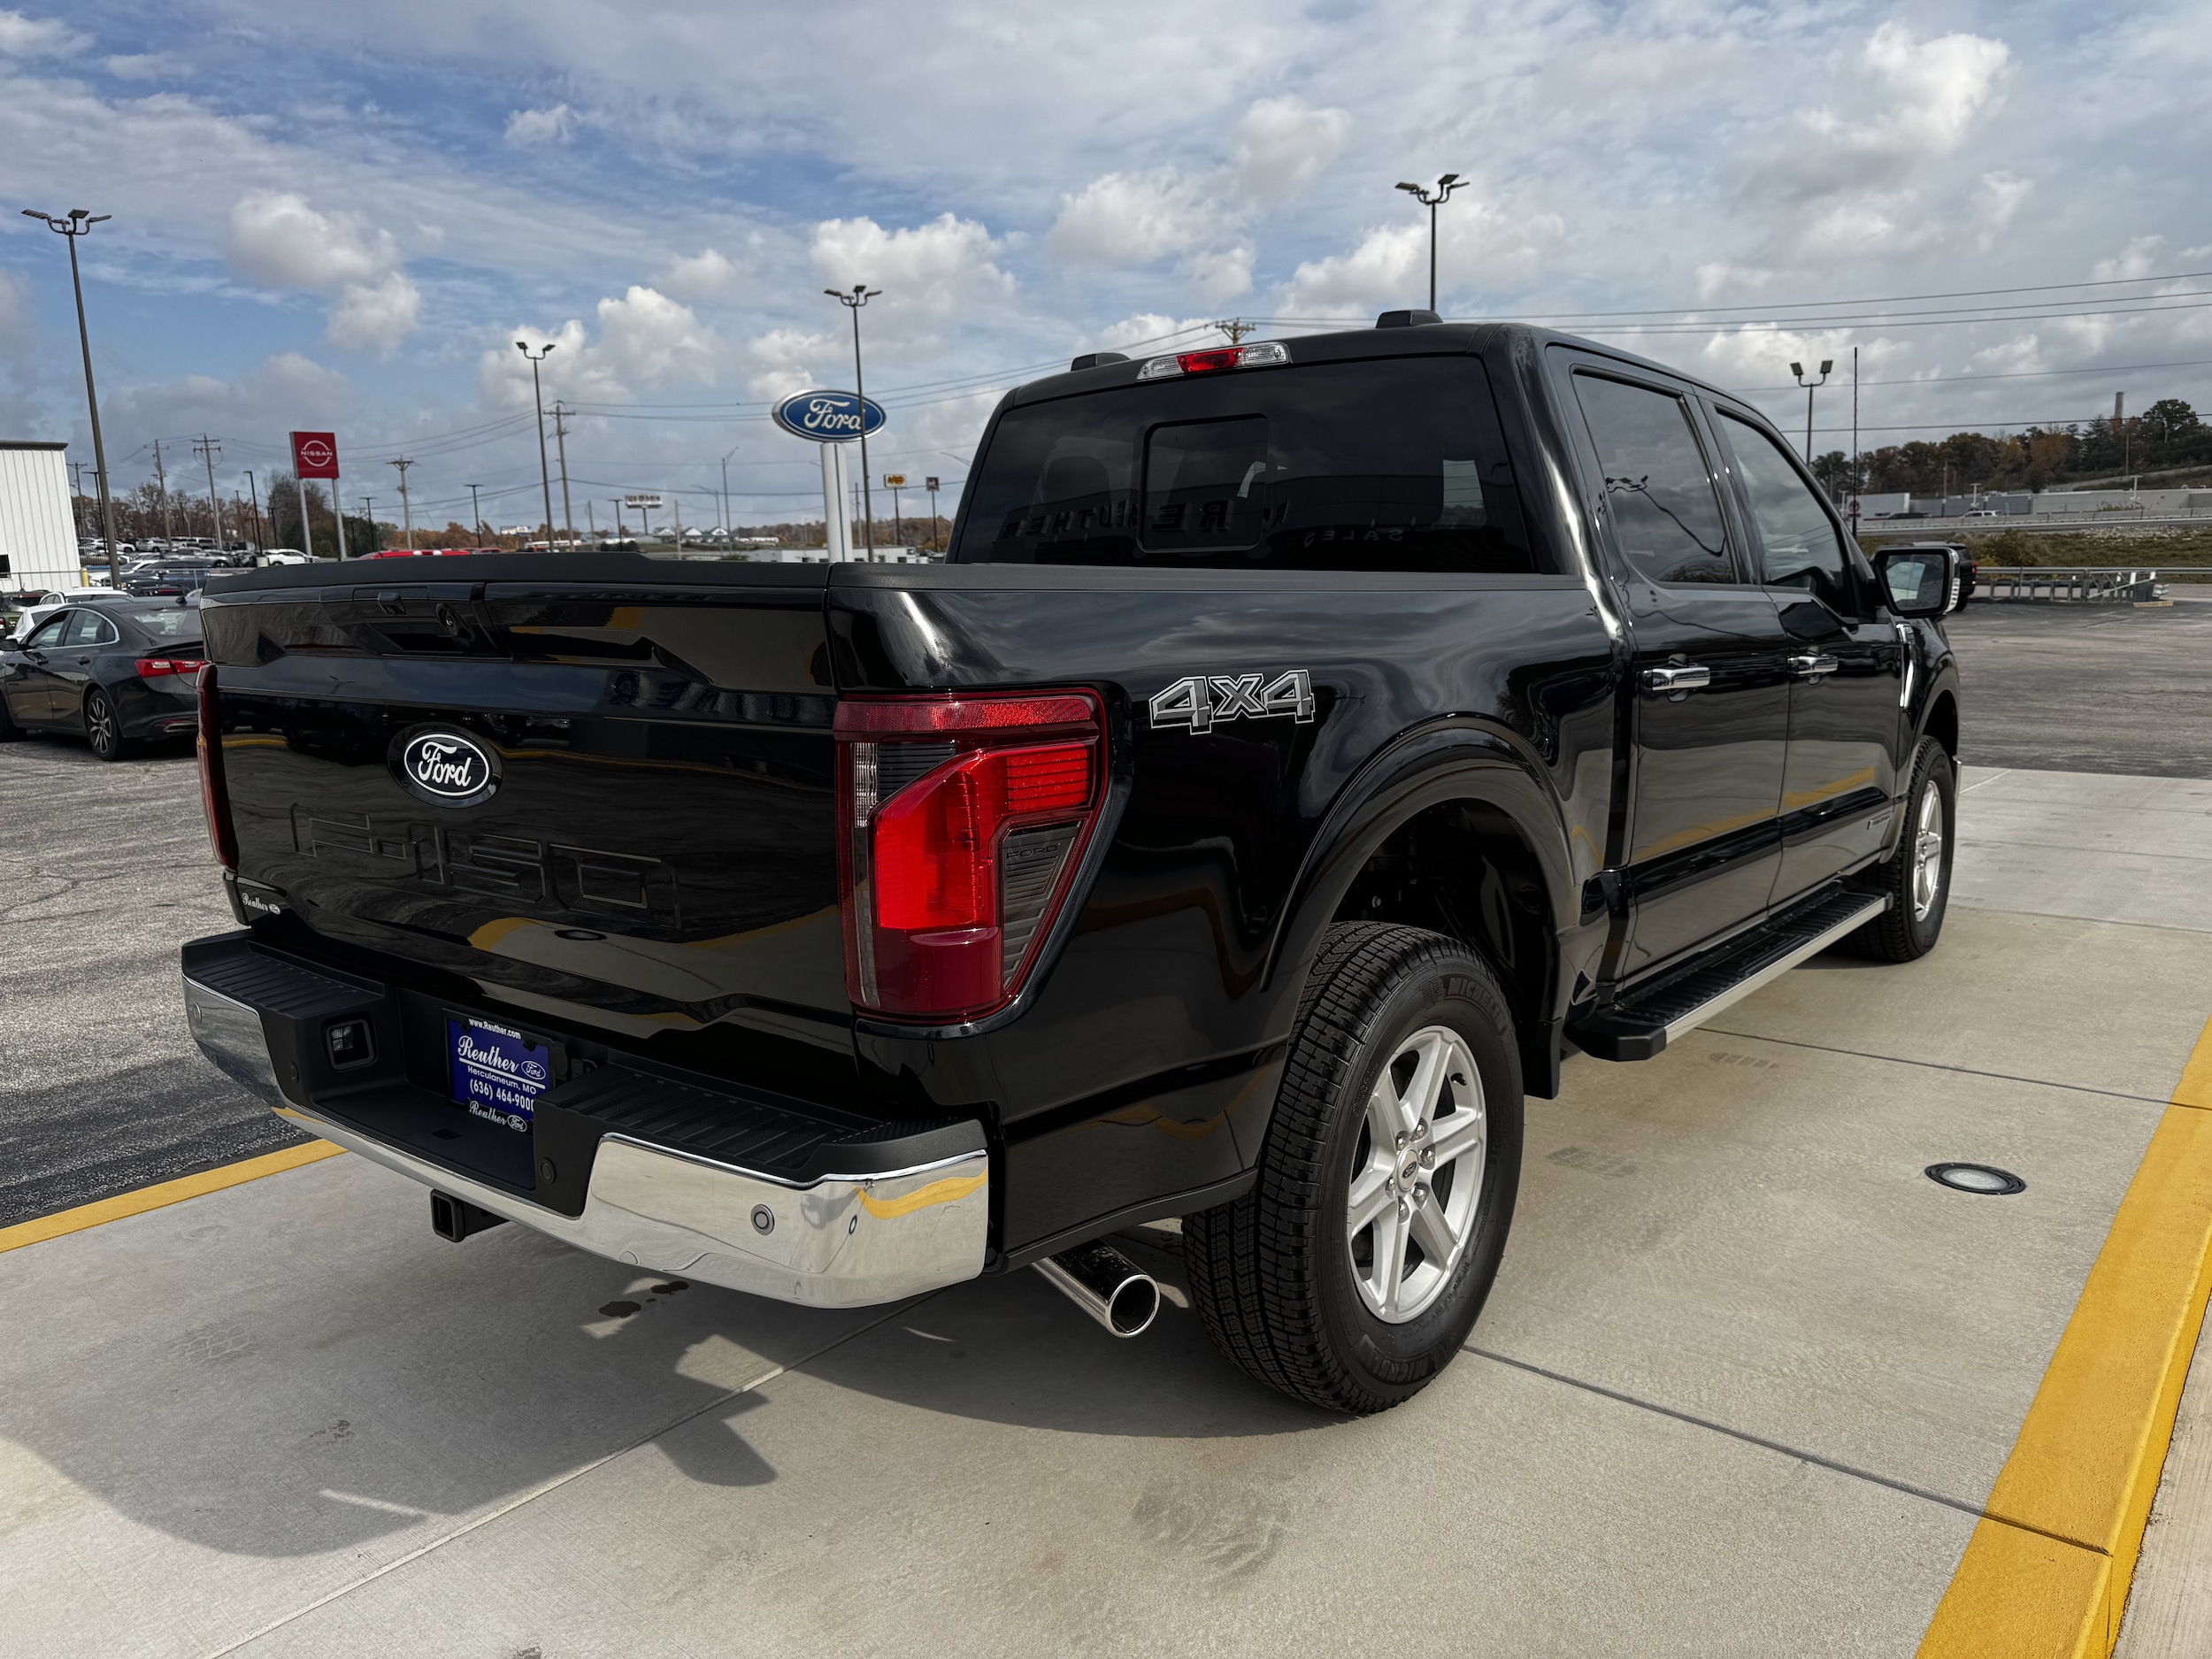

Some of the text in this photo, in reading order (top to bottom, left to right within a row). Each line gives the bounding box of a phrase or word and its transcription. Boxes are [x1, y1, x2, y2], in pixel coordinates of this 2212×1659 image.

[418, 741, 472, 787] Ford
[1006, 845, 1057, 859] FORD
[468, 1018, 521, 1040] www.Reuther.com
[457, 1035, 542, 1078] Reuther Ford
[467, 1065, 537, 1095] Herculaneum, MO
[470, 1079, 494, 1101] (636)
[469, 1101, 507, 1125] Reuther
